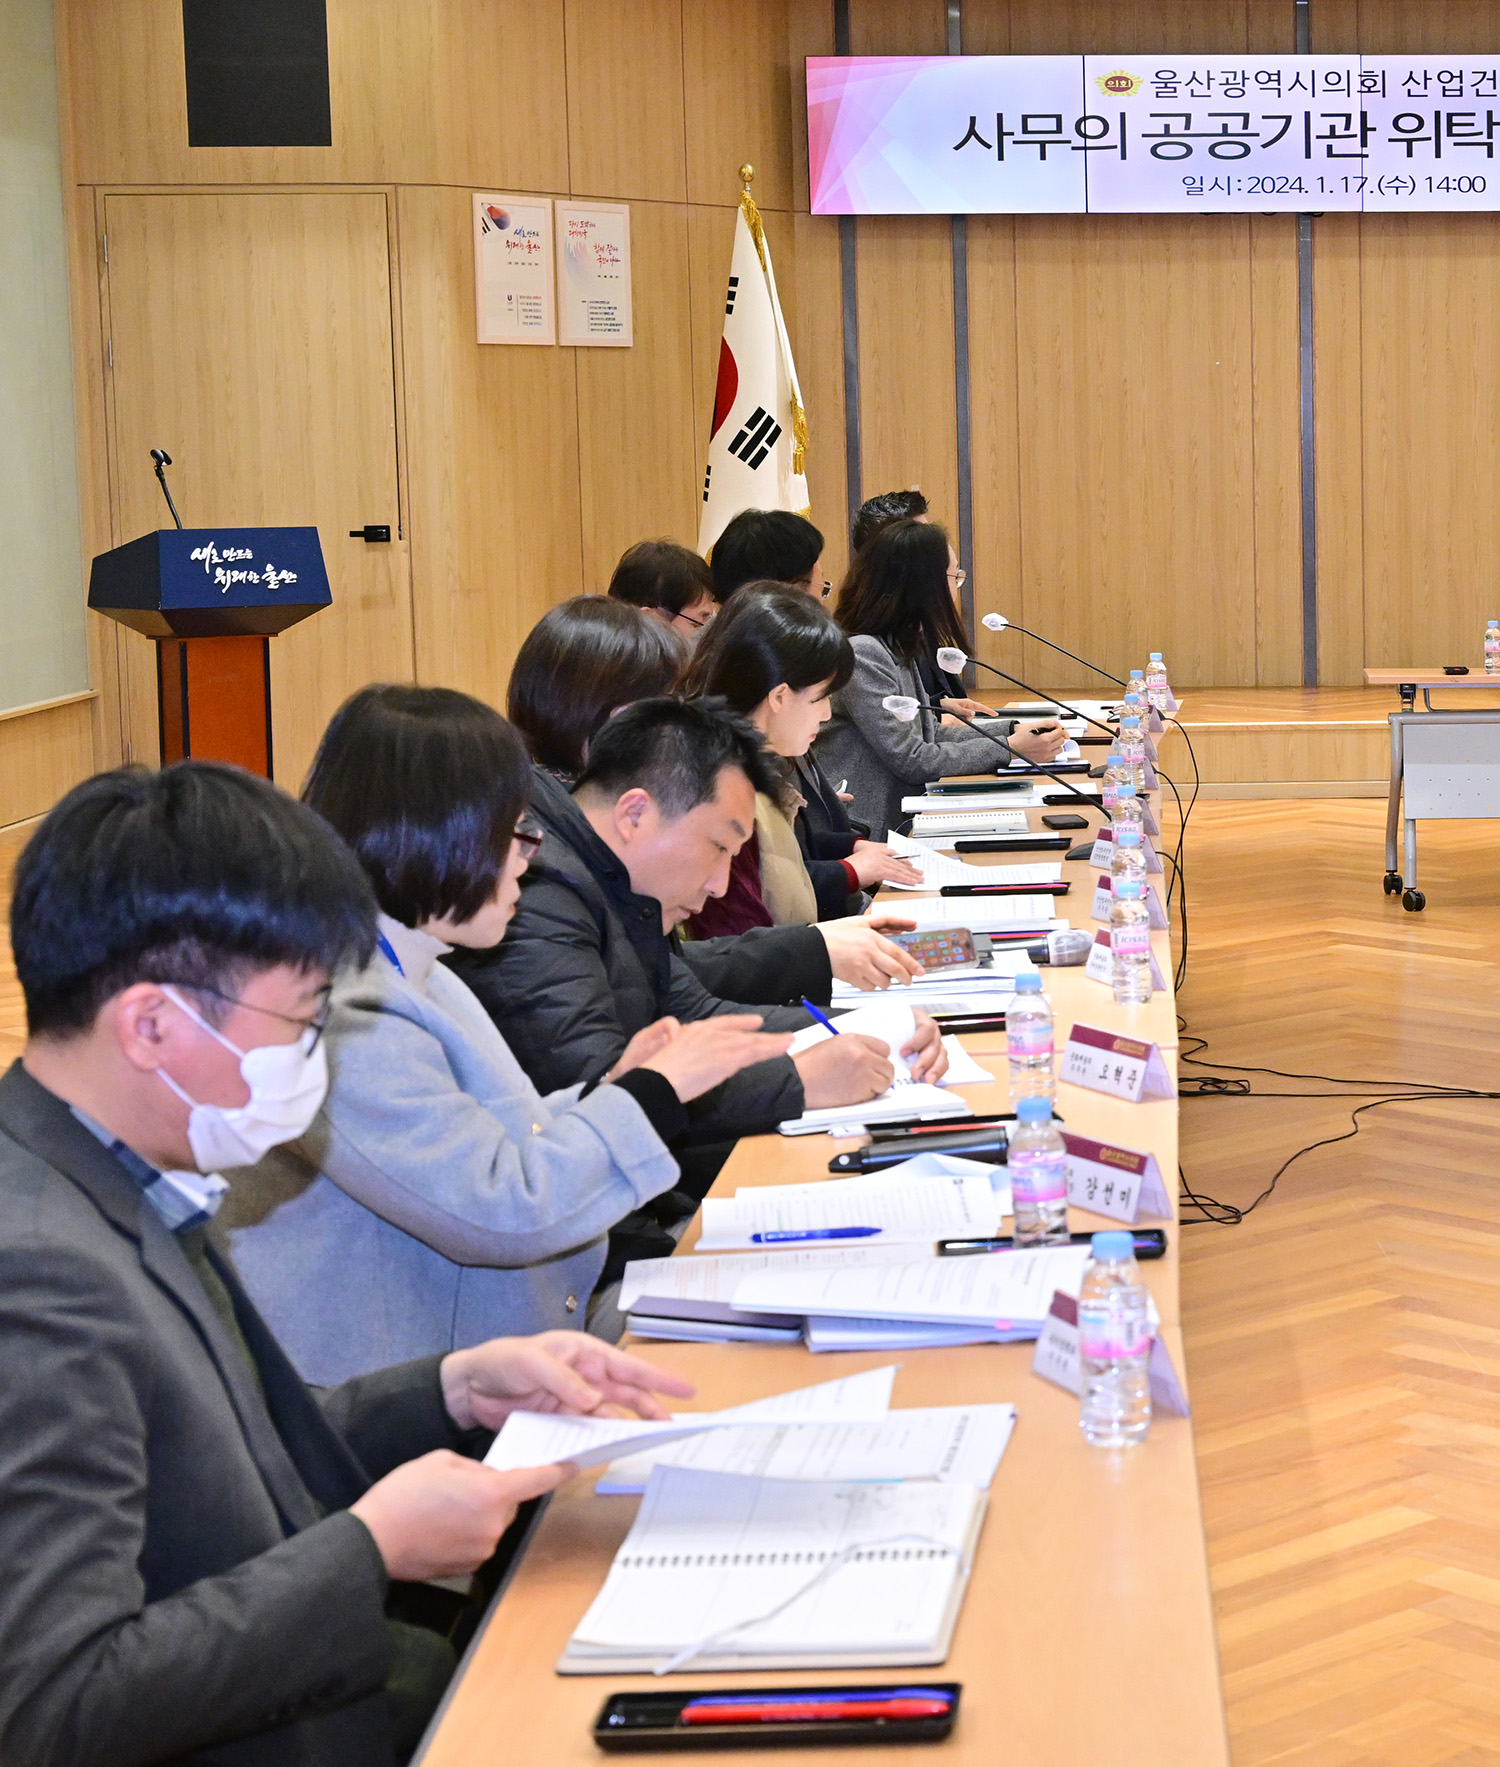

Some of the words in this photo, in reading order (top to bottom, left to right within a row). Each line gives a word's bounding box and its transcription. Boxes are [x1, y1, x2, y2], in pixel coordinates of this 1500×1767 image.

[1150, 69, 1386, 99] 울산광역시의회
[952, 111, 1127, 162] 사무의
[1141, 109, 1376, 160] 공공기관
[1340, 174, 1416, 197] 17.(수)
[1424, 175, 1487, 194] 14:00
[190, 541, 224, 574] 새로
[222, 547, 253, 562] 만드는
[213, 567, 260, 593] 위대한
[261, 563, 297, 589] 울산
